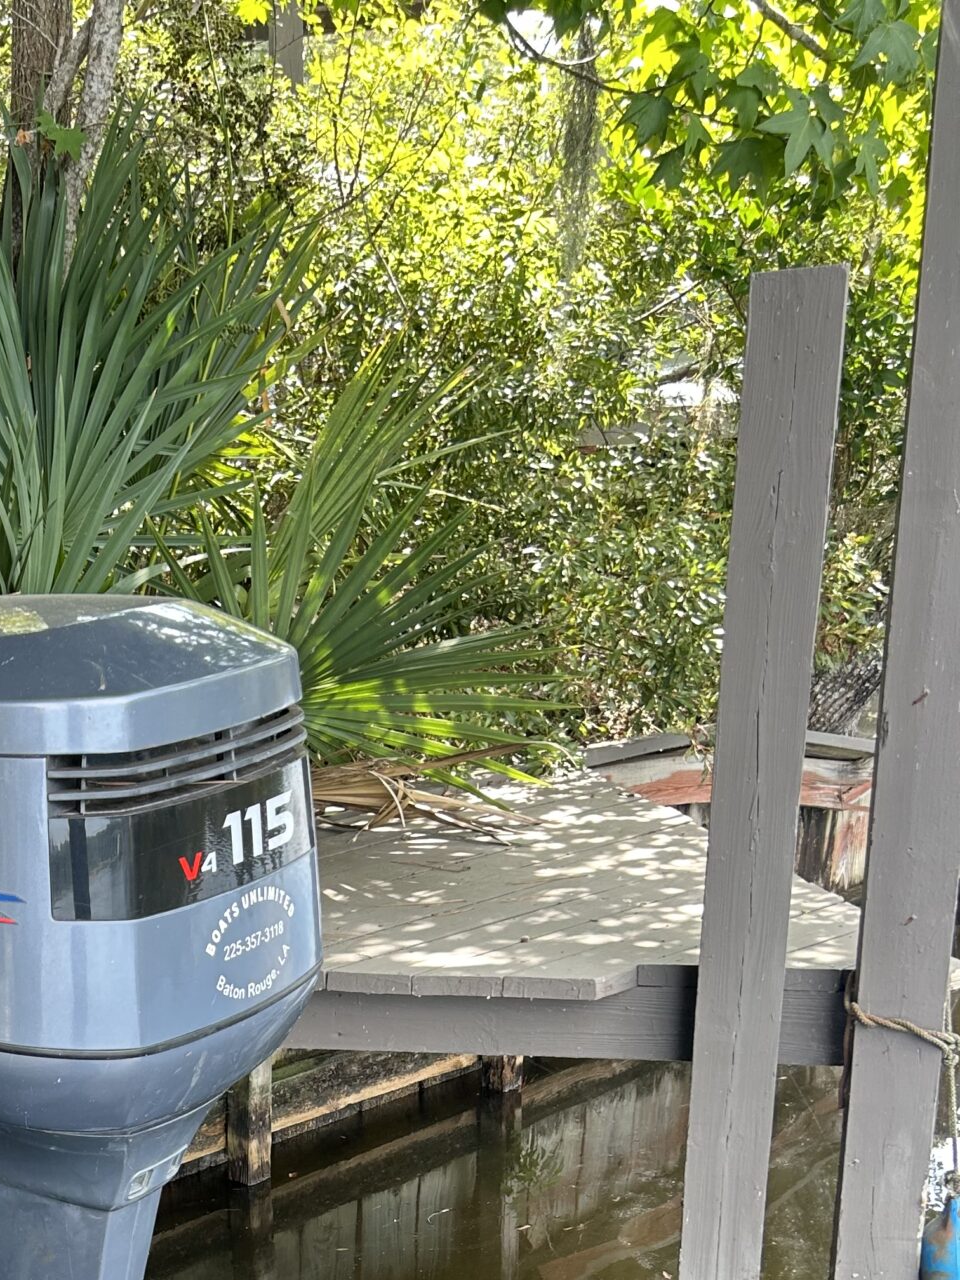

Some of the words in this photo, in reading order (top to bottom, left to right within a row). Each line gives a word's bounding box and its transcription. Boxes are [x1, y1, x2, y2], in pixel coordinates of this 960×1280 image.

[178, 851, 218, 881] V4
[222, 790, 295, 866] 115
[205, 902, 240, 957] BOATS
[241, 886, 295, 918] UNLIMITED
[223, 920, 284, 961] 225-357-3118
[216, 974, 246, 999] Baton
